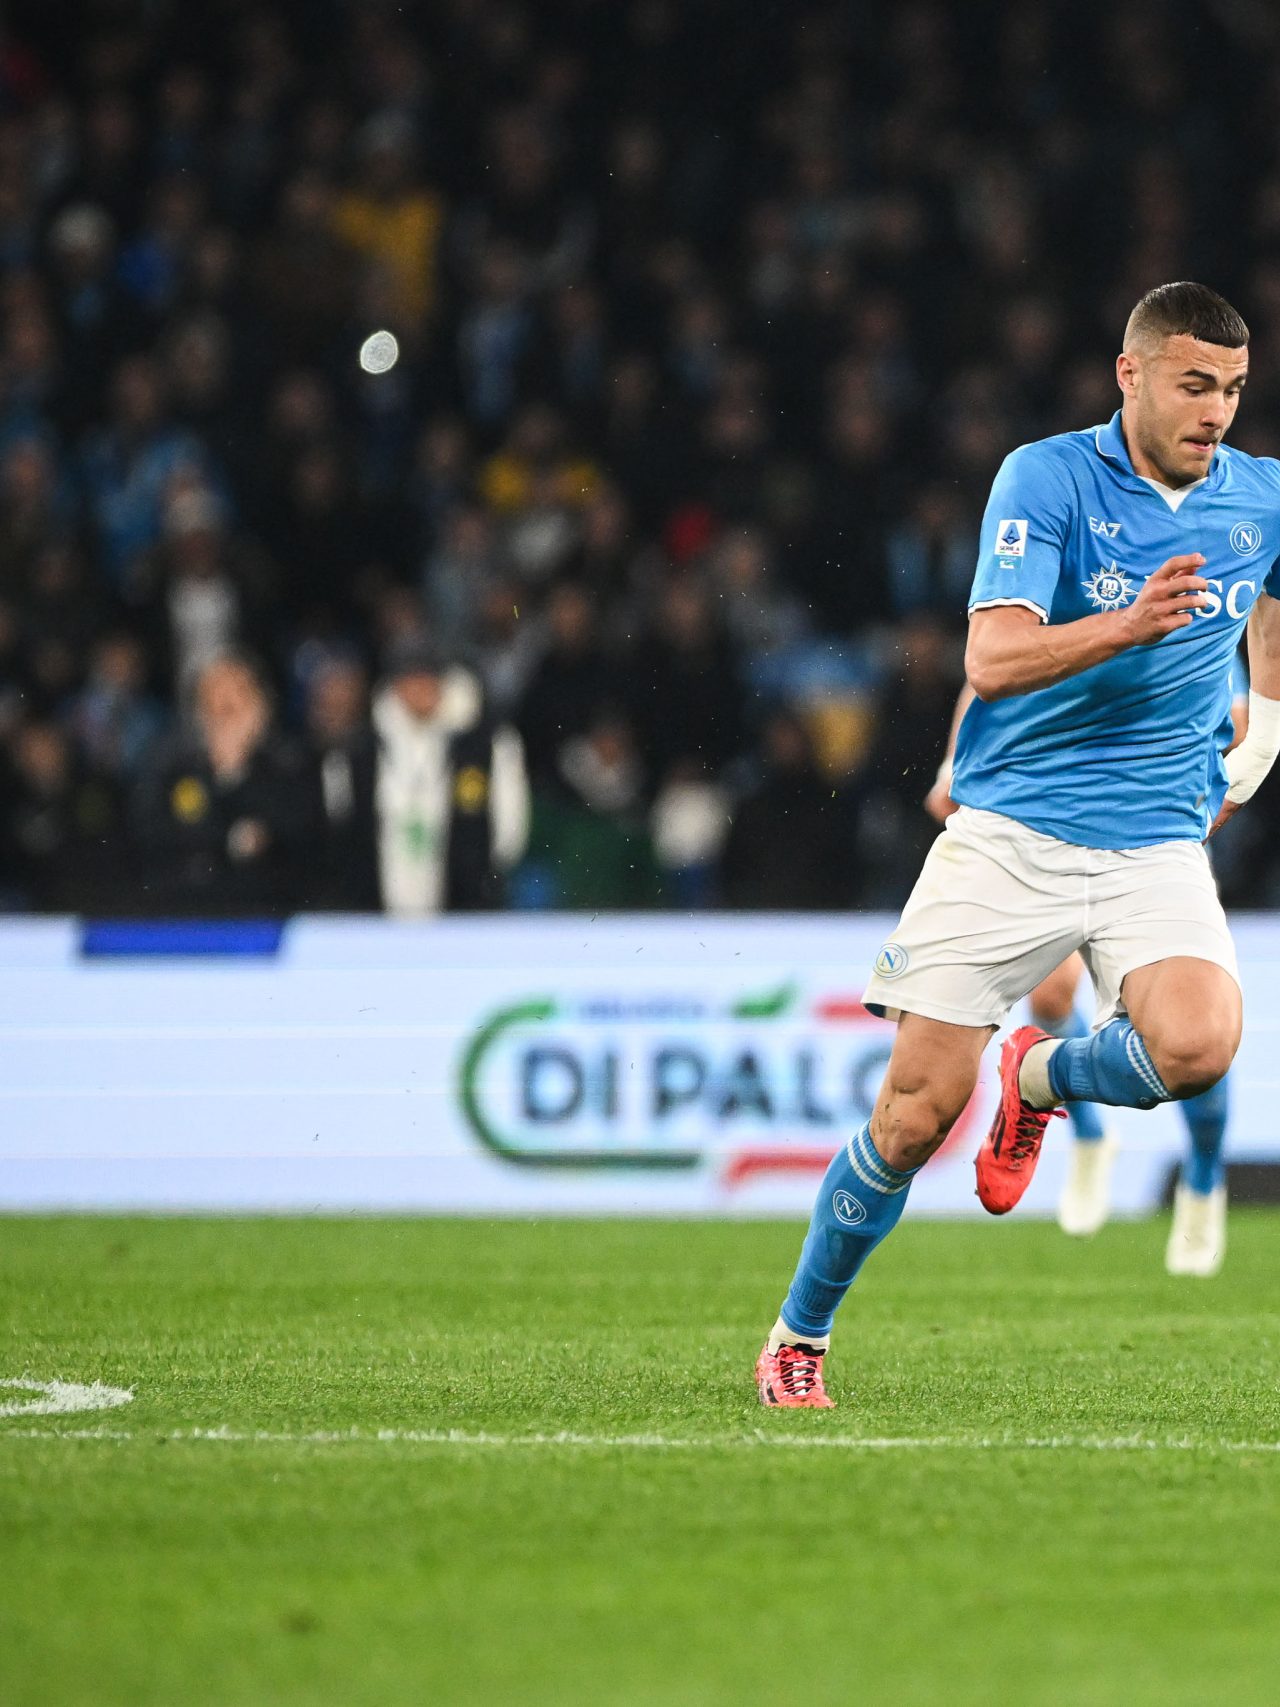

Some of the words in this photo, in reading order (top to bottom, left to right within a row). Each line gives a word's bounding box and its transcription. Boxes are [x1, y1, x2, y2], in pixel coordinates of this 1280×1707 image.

[1089, 516, 1122, 538] EA7
[1239, 530, 1252, 546] N
[879, 950, 899, 969] N
[523, 1045, 618, 1123] DI
[838, 1198, 857, 1217] N
